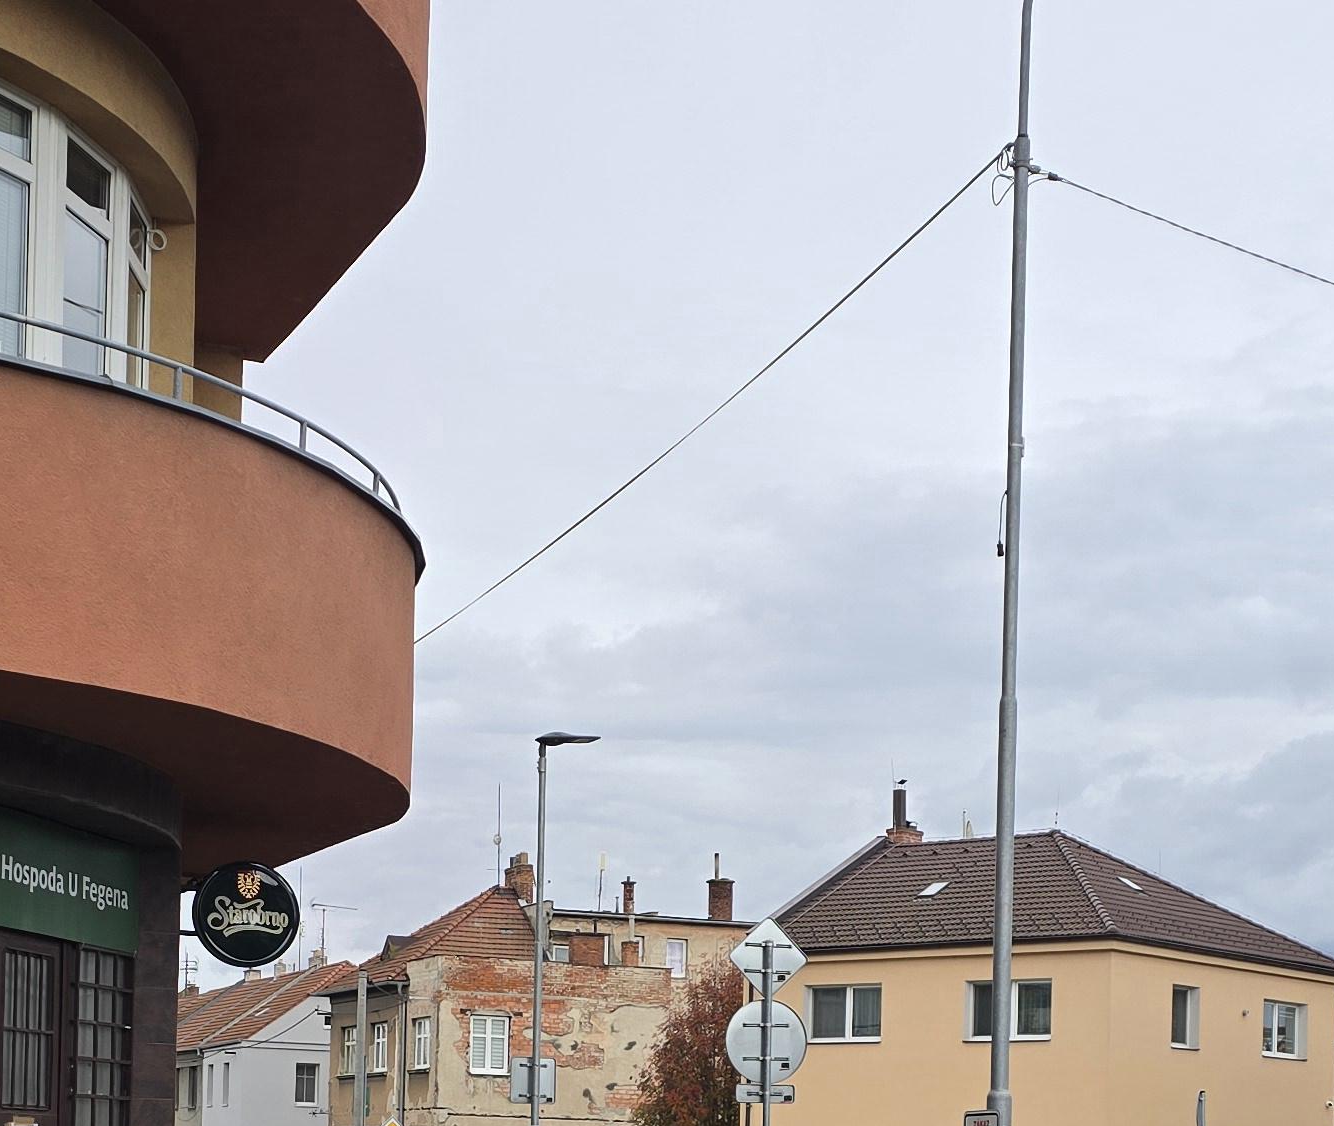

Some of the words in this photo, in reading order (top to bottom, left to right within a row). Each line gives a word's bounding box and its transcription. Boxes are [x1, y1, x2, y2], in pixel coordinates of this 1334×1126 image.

[0, 854, 65, 895] Hospoda
[68, 871, 79, 897] U
[82, 876, 129, 910] Fegena
[207, 895, 289, 937] Starobrno
